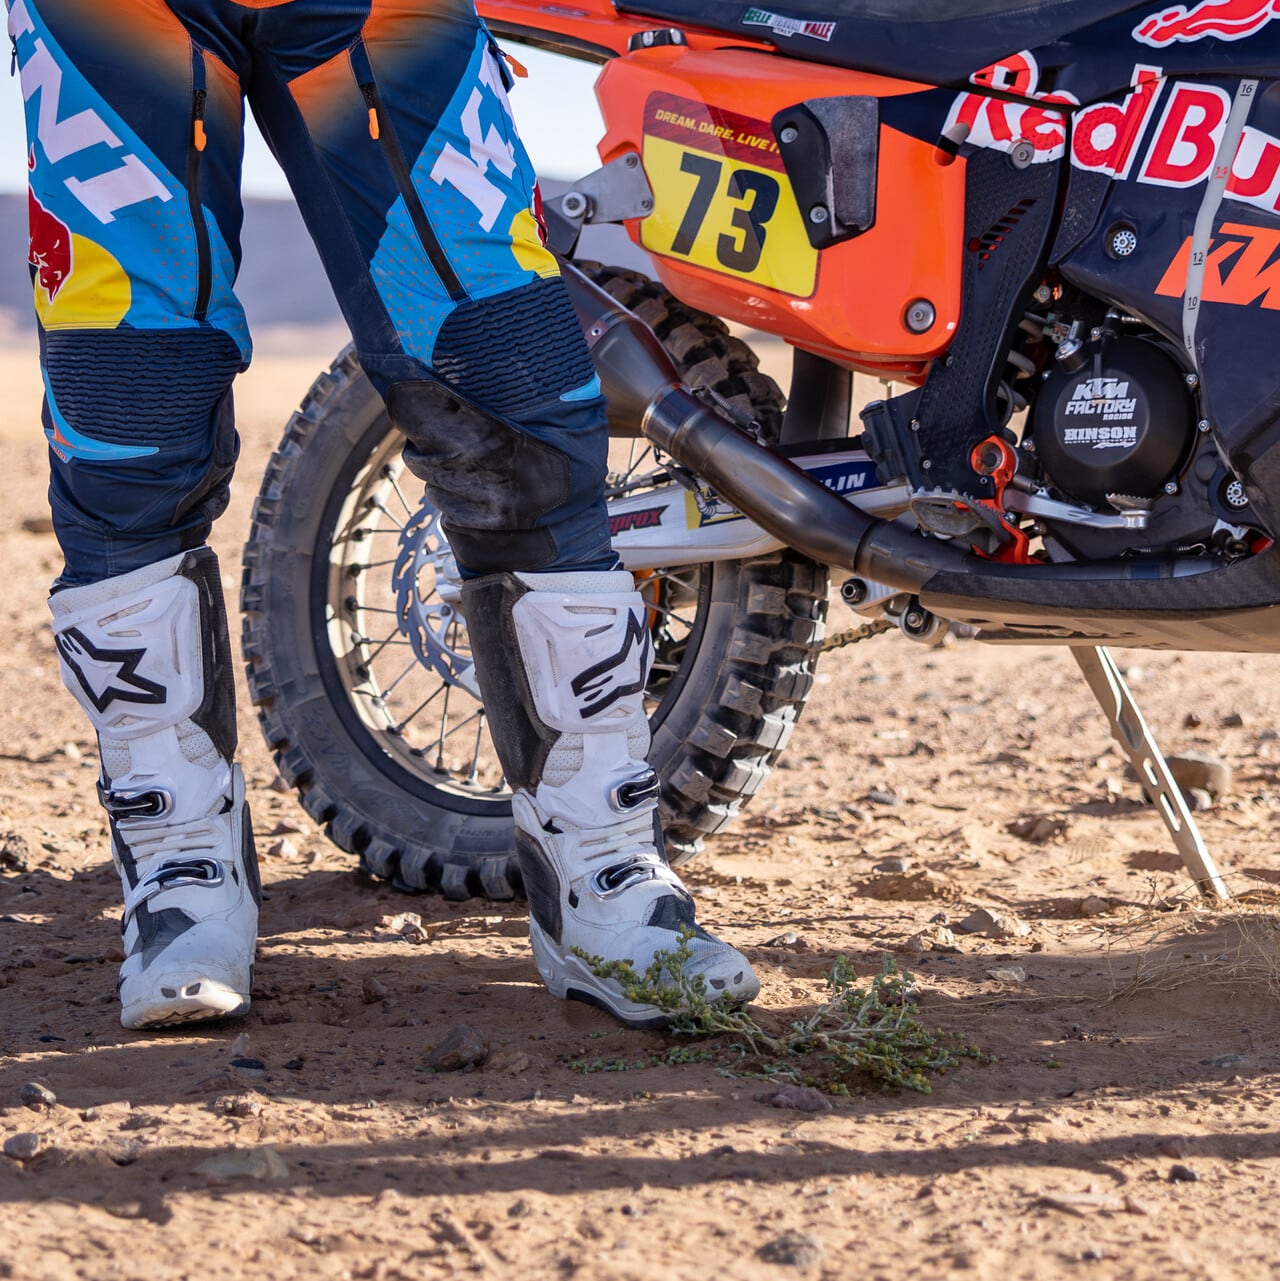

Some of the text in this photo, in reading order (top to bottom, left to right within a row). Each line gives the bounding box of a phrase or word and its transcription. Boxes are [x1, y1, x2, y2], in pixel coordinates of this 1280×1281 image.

[803, 22, 833, 39] VALLE
[1242, 84, 1253, 95] 16
[946, 49, 1167, 180] Red
[655, 109, 696, 130] DREAM.
[698, 122, 734, 141] DARE.
[736, 133, 770, 150] LIVE
[1215, 166, 1228, 176] 14
[671, 151, 780, 272] 73
[1193, 252, 1204, 263] 12
[1187, 296, 1198, 307] 10
[1072, 377, 1129, 401] KTM
[1064, 398, 1137, 416] FACTORY
[1102, 412, 1134, 421] RACING
[1064, 426, 1137, 441] HINSON
